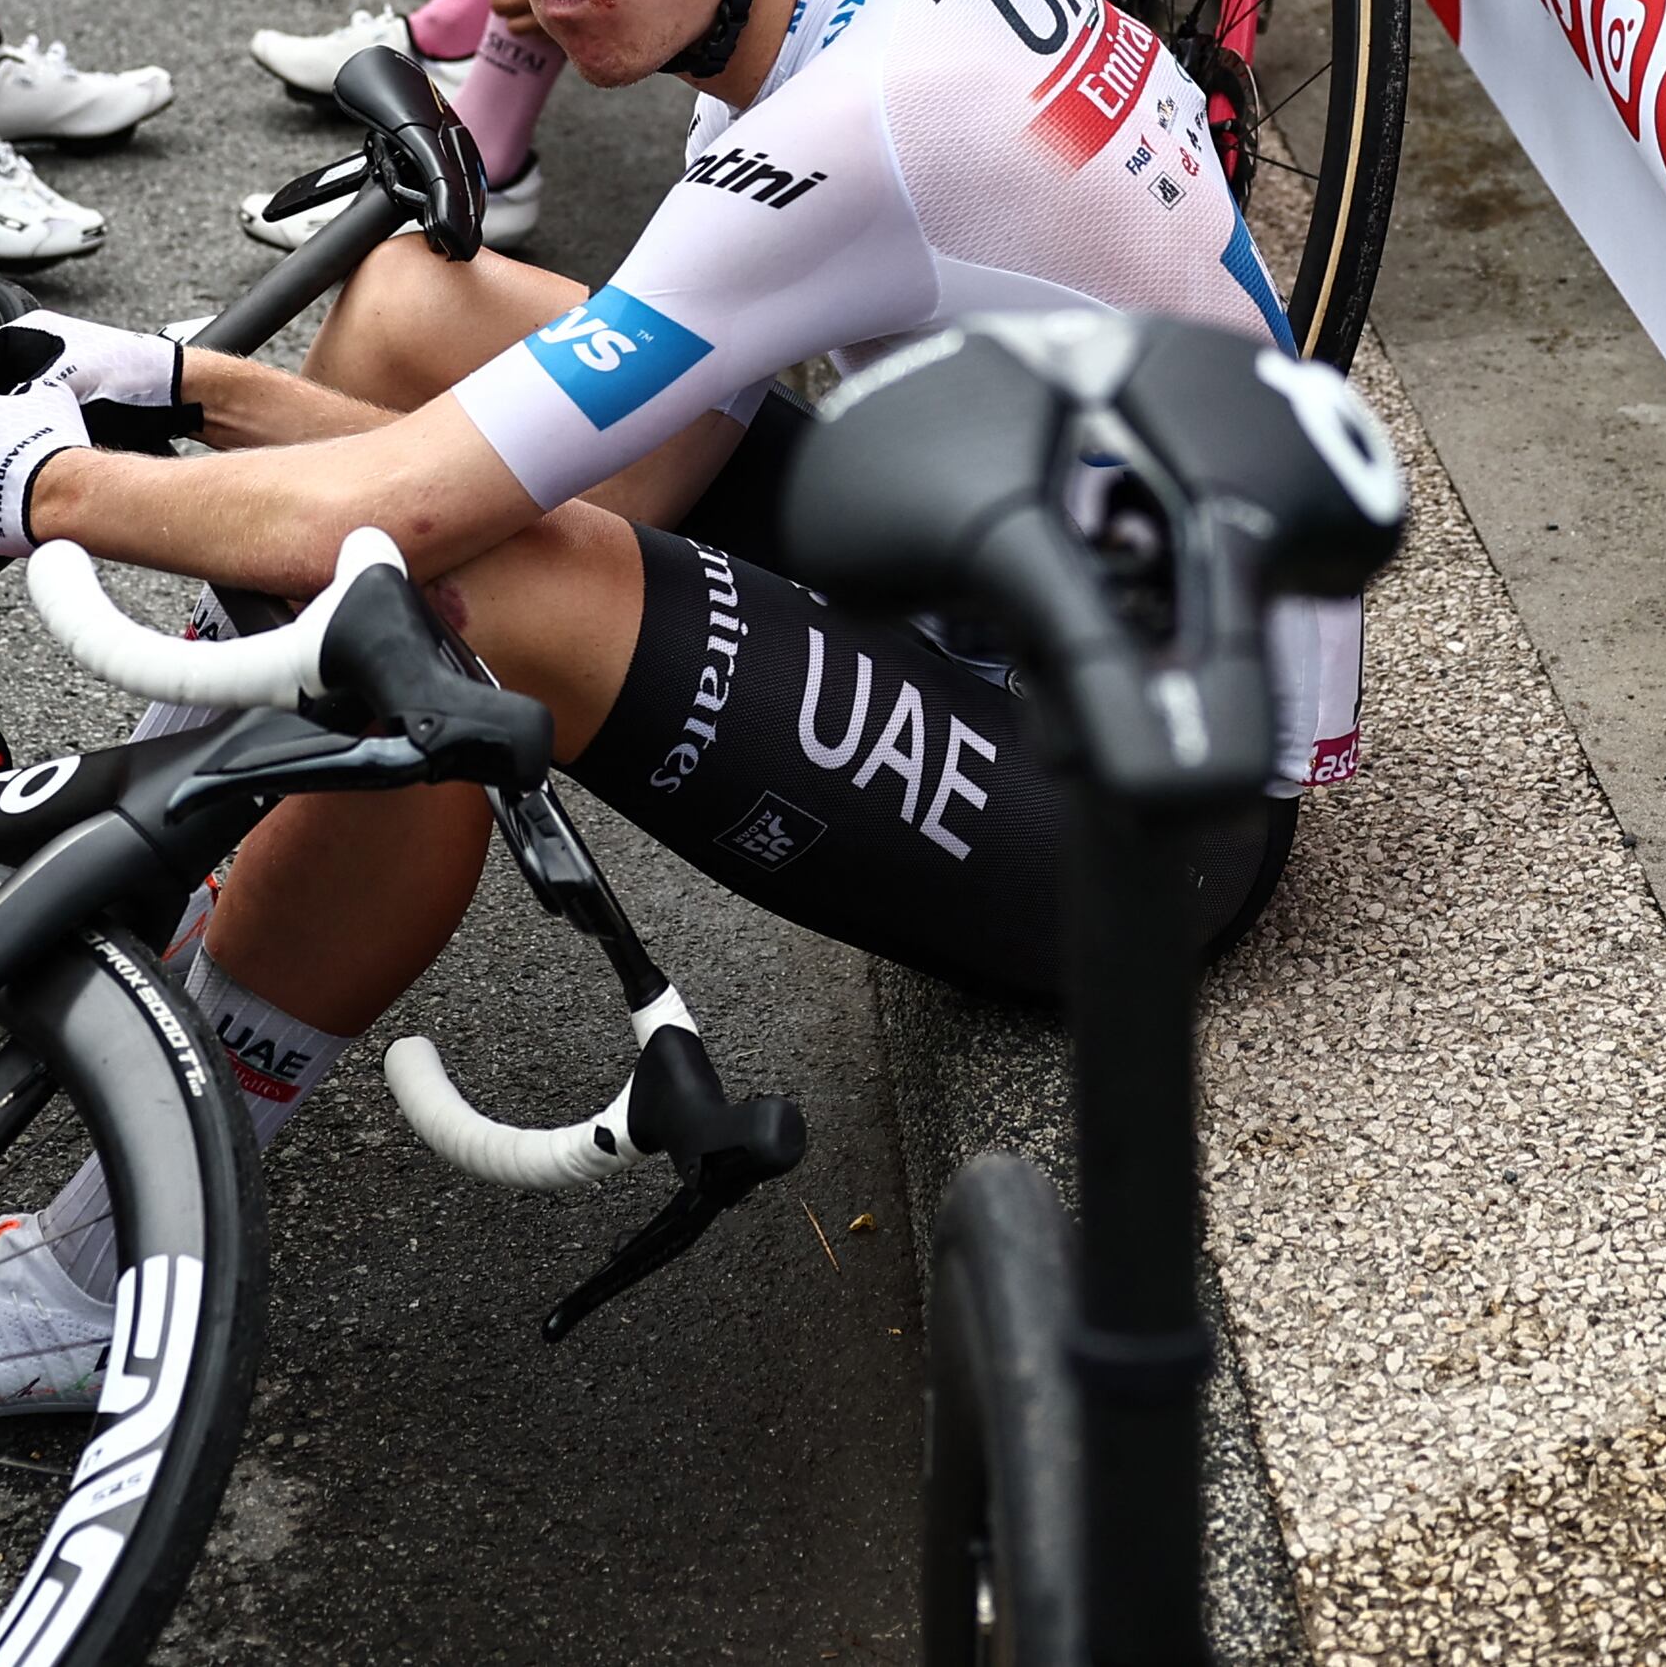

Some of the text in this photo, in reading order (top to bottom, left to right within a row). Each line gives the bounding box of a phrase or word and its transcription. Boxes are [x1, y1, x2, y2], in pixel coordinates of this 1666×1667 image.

[1077, 19, 1155, 119] Emira
[676, 146, 828, 214] ntini
[537, 301, 637, 374] ys
[798, 625, 999, 863] UAE
[94, 940, 149, 989] PRIX
[136, 986, 191, 1049] 5000
[178, 1048, 208, 1085] TT
[216, 1013, 312, 1080] UAE
